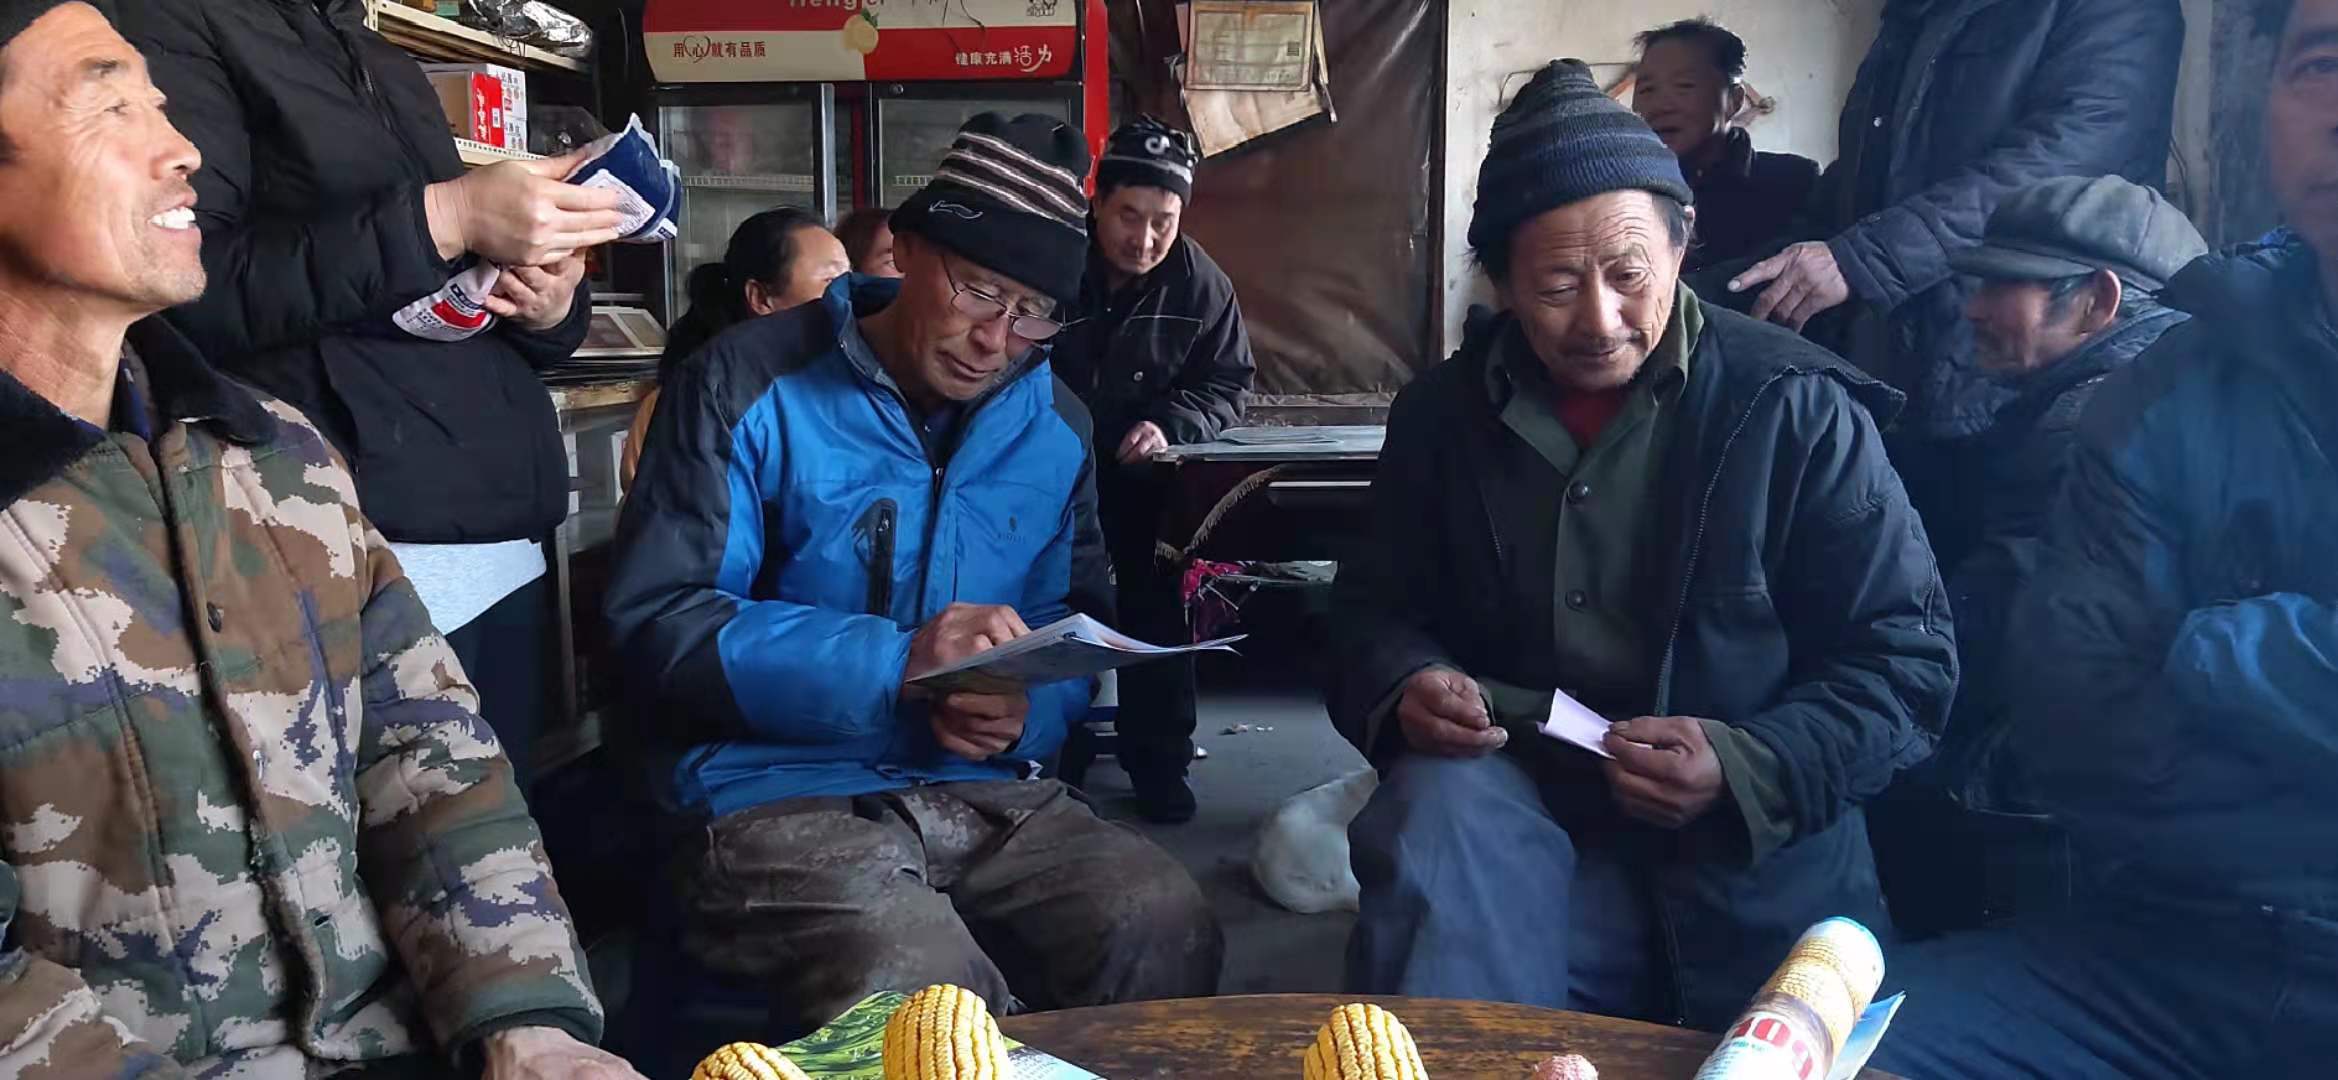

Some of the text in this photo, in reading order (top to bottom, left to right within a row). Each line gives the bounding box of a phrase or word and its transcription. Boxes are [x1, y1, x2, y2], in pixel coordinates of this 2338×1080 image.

[673, 36, 766, 63] 用心就有品质
[955, 43, 1052, 72] 健康充满活力
